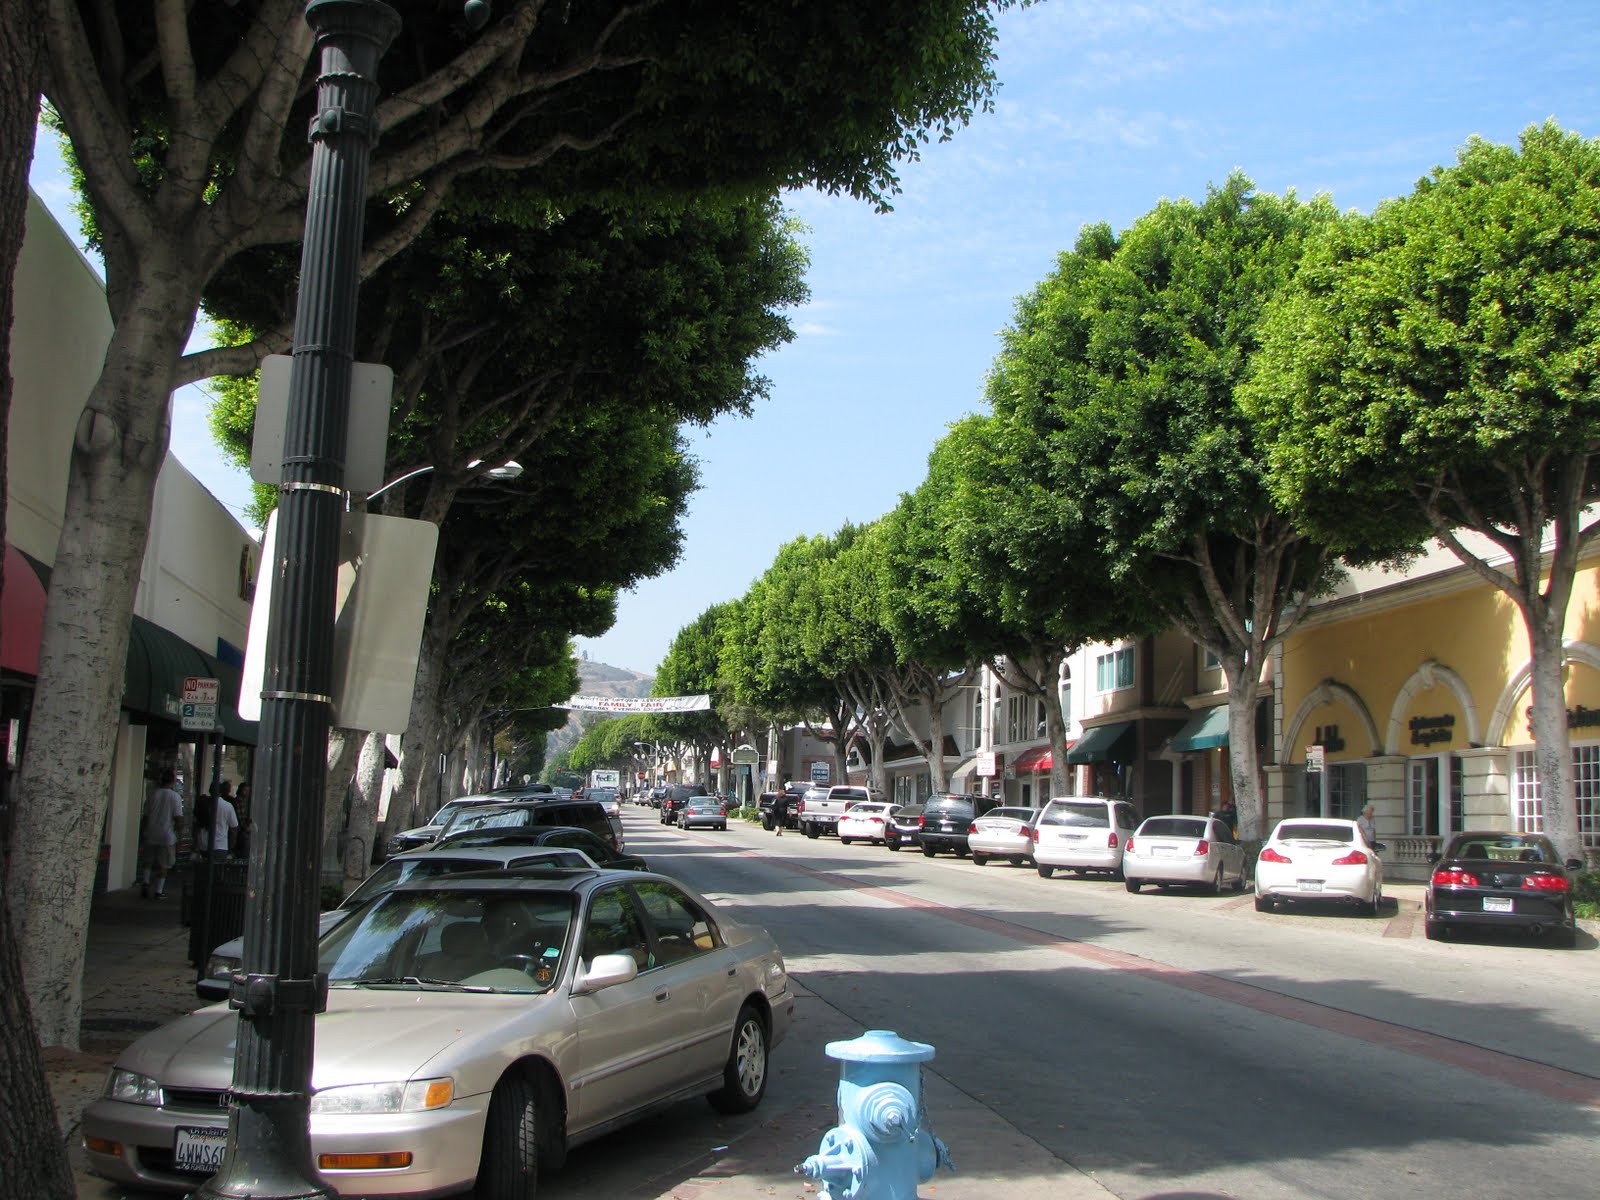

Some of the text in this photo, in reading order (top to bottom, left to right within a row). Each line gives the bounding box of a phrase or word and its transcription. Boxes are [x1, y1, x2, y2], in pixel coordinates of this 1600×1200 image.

[185, 679, 218, 690] NO PARKING
[184, 705, 193, 716] 2
[596, 774, 617, 782] FedEx
